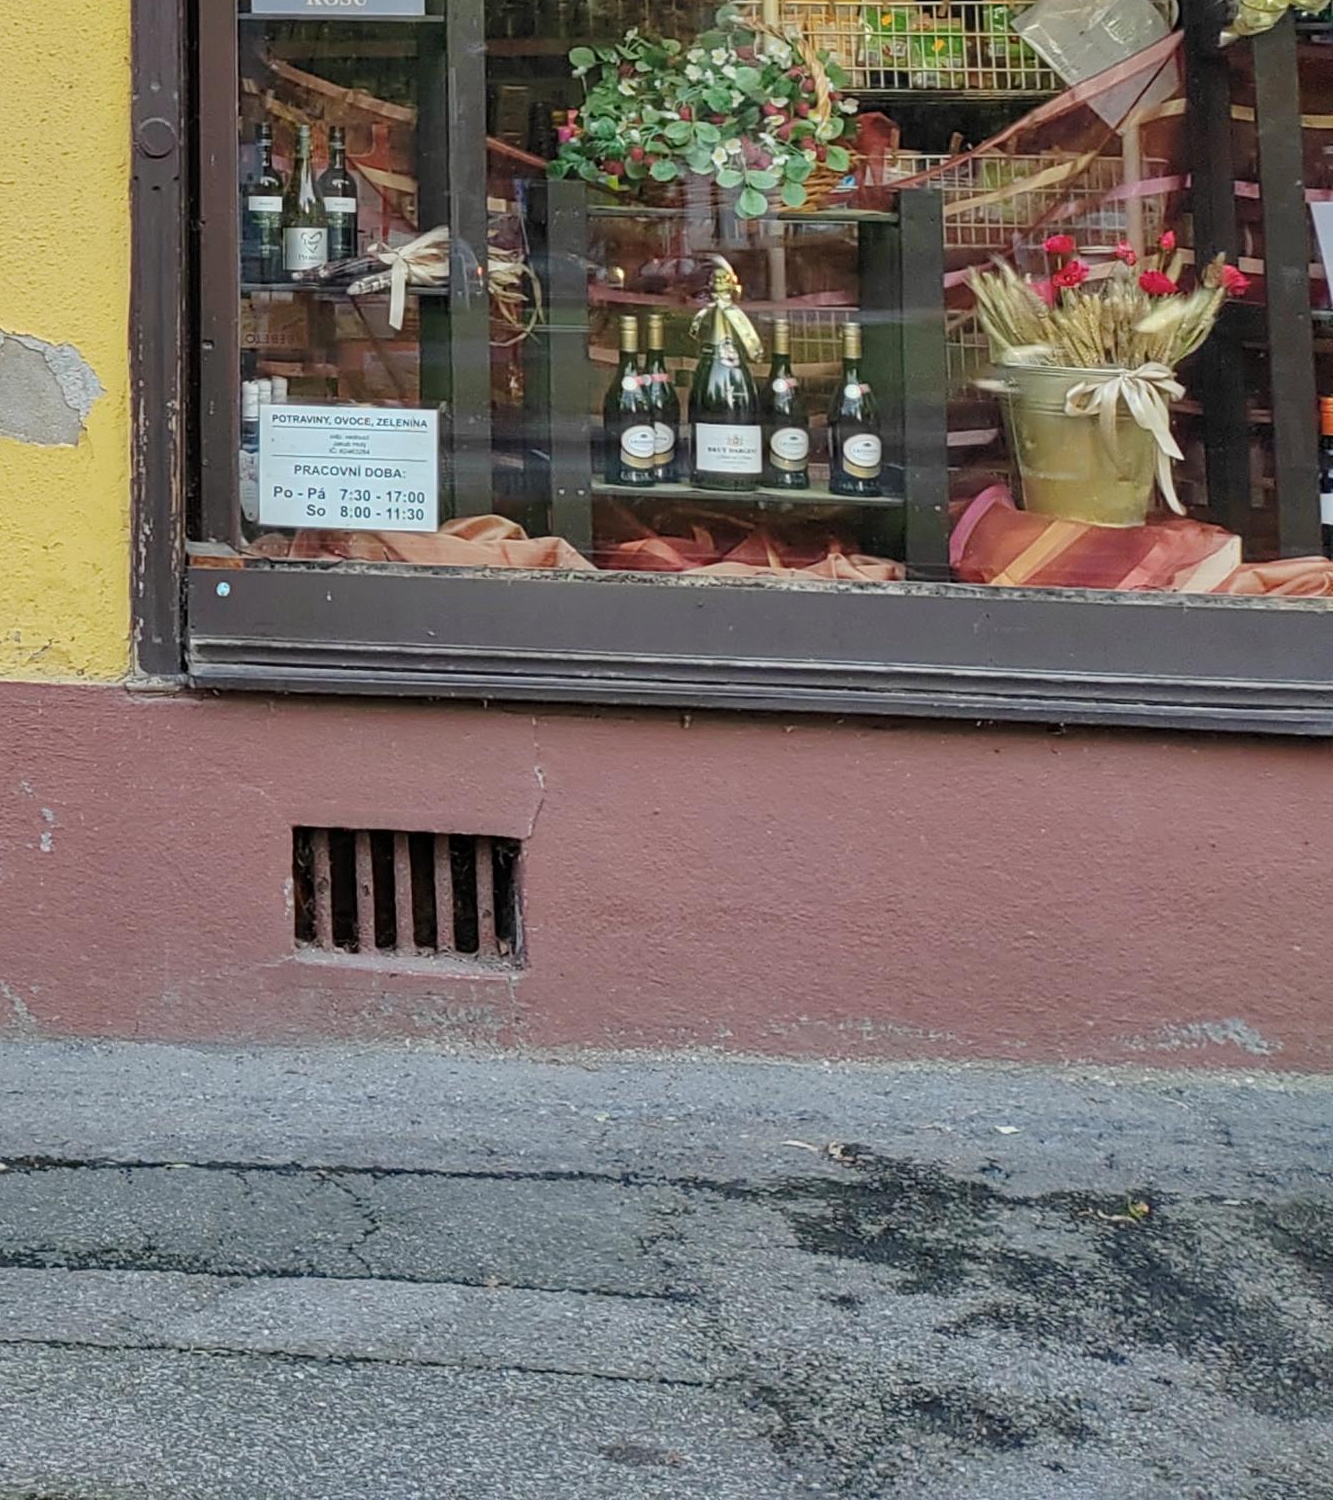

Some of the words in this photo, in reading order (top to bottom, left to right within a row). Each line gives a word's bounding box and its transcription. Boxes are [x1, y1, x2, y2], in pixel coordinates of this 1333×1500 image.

[293, 464, 362, 477] PRACOVNÍ
[364, 467, 407, 479] DOBA:
[273, 485, 294, 499] Po
[307, 486, 326, 500] Pá
[339, 488, 371, 502] 7:30
[386, 490, 426, 504] 17:00
[305, 504, 327, 517] So
[386, 507, 425, 521] 11:30
